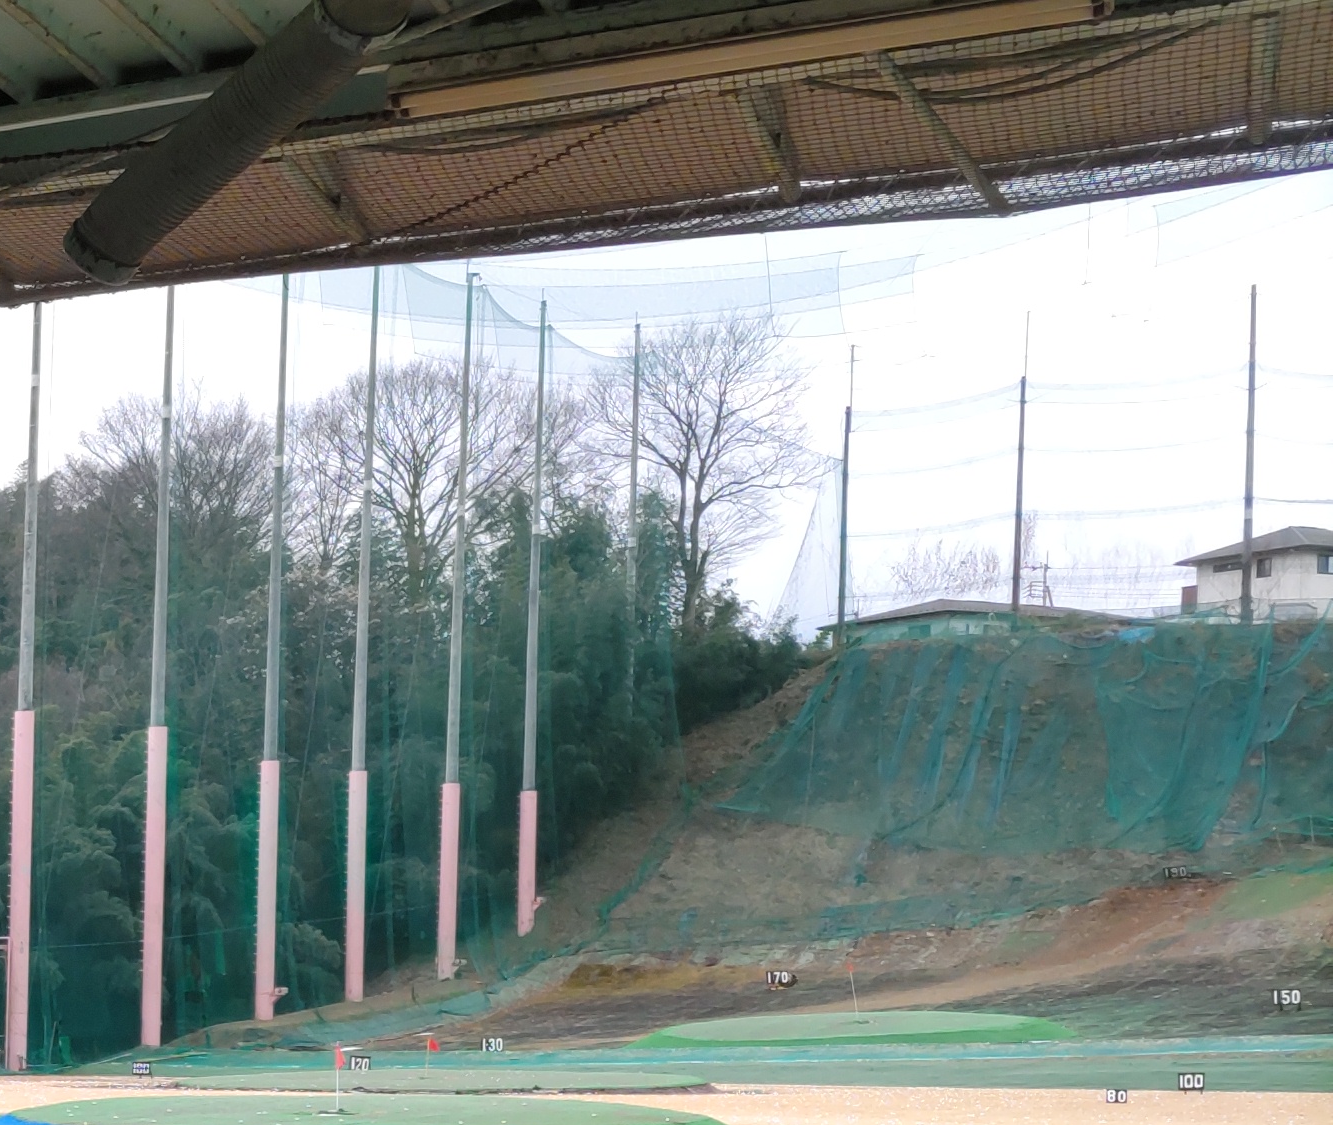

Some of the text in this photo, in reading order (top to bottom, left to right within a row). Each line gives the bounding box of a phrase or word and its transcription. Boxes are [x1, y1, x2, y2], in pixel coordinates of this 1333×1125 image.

[1164, 866, 1187, 878] 190
[767, 971, 788, 984] 170
[1273, 989, 1301, 1005] 150
[482, 1037, 503, 1052] 130
[350, 1056, 370, 1071] 120
[1179, 1074, 1204, 1089] 100
[1107, 1089, 1127, 1103] 80
